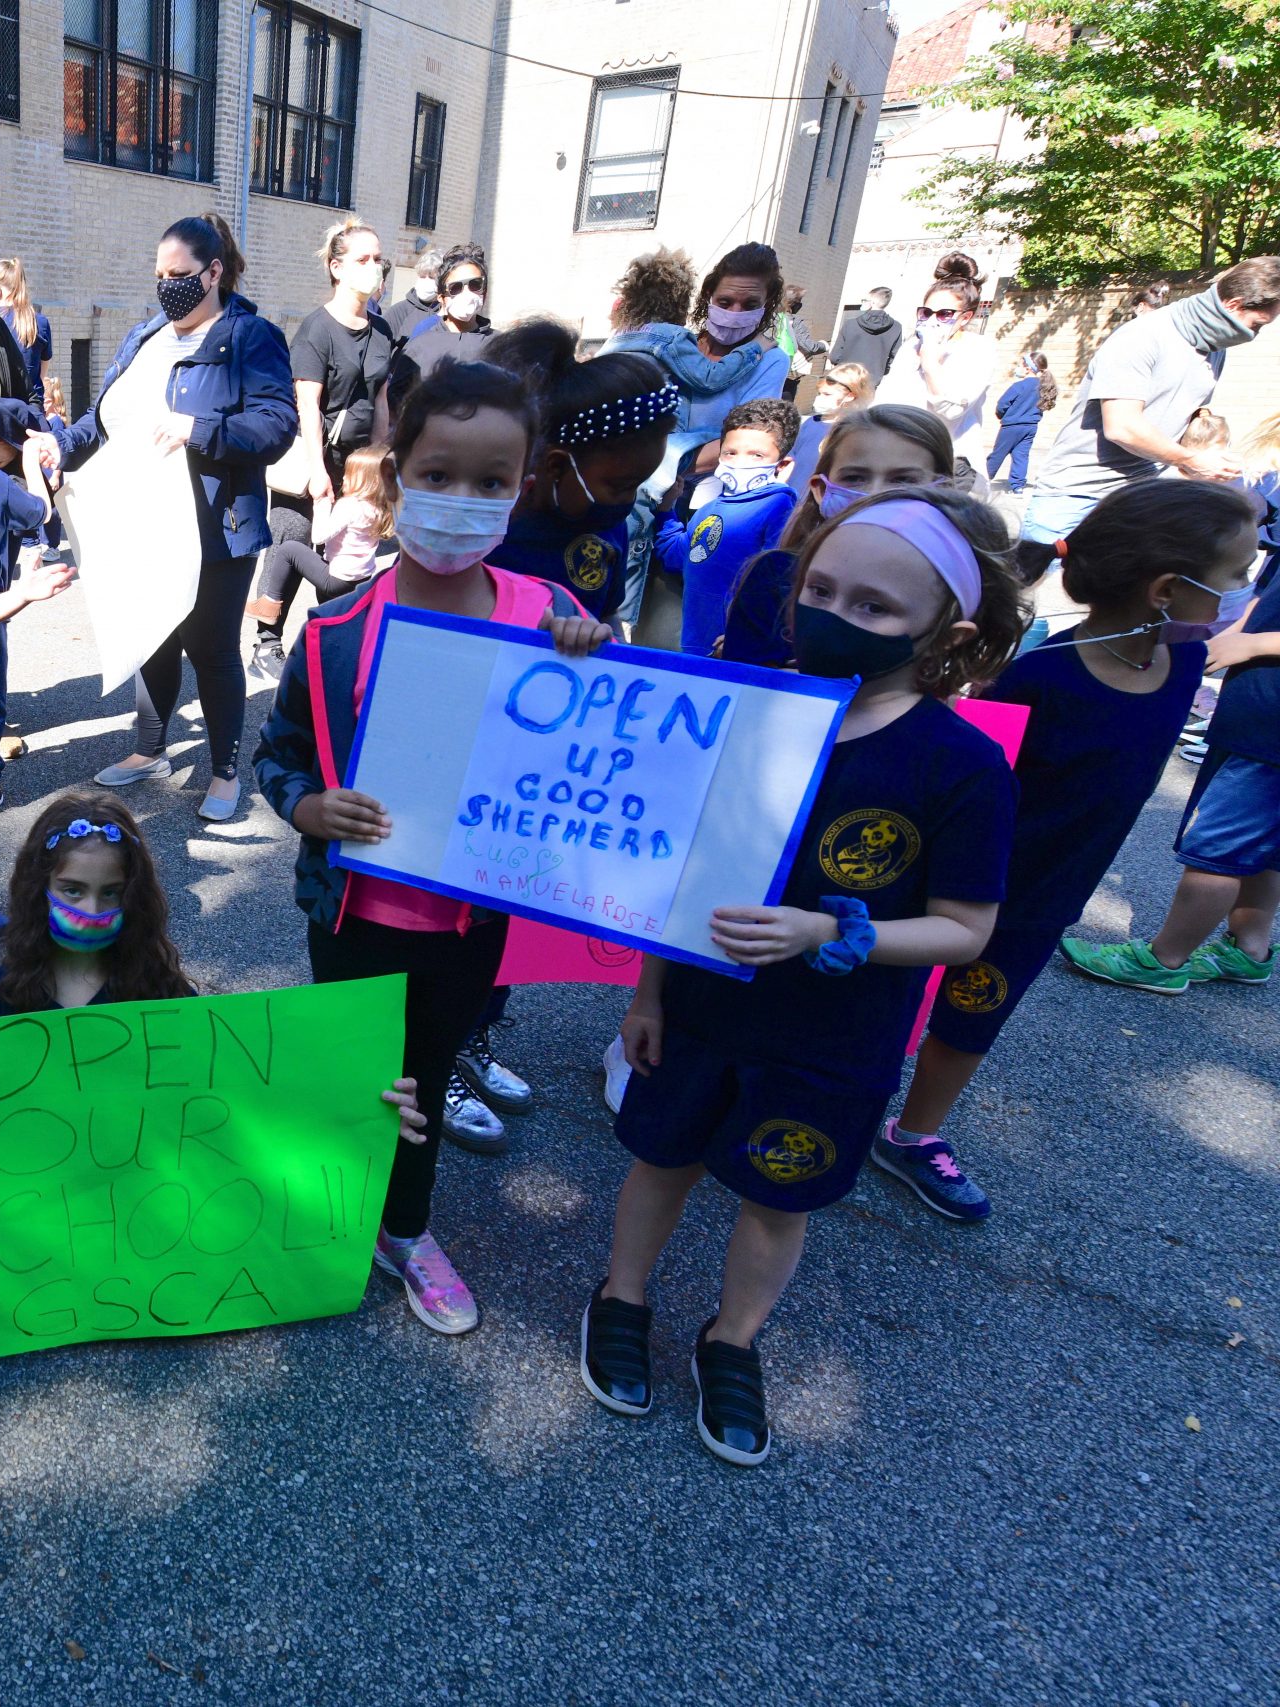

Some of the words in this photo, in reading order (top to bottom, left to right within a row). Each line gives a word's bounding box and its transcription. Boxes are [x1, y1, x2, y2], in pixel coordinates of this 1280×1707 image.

[504, 660, 731, 750] OPEN
[566, 742, 634, 784] UP
[458, 793, 674, 860] SHEPHERD
[515, 772, 645, 822] GOOD
[12, 1266, 278, 1338] GSCA
